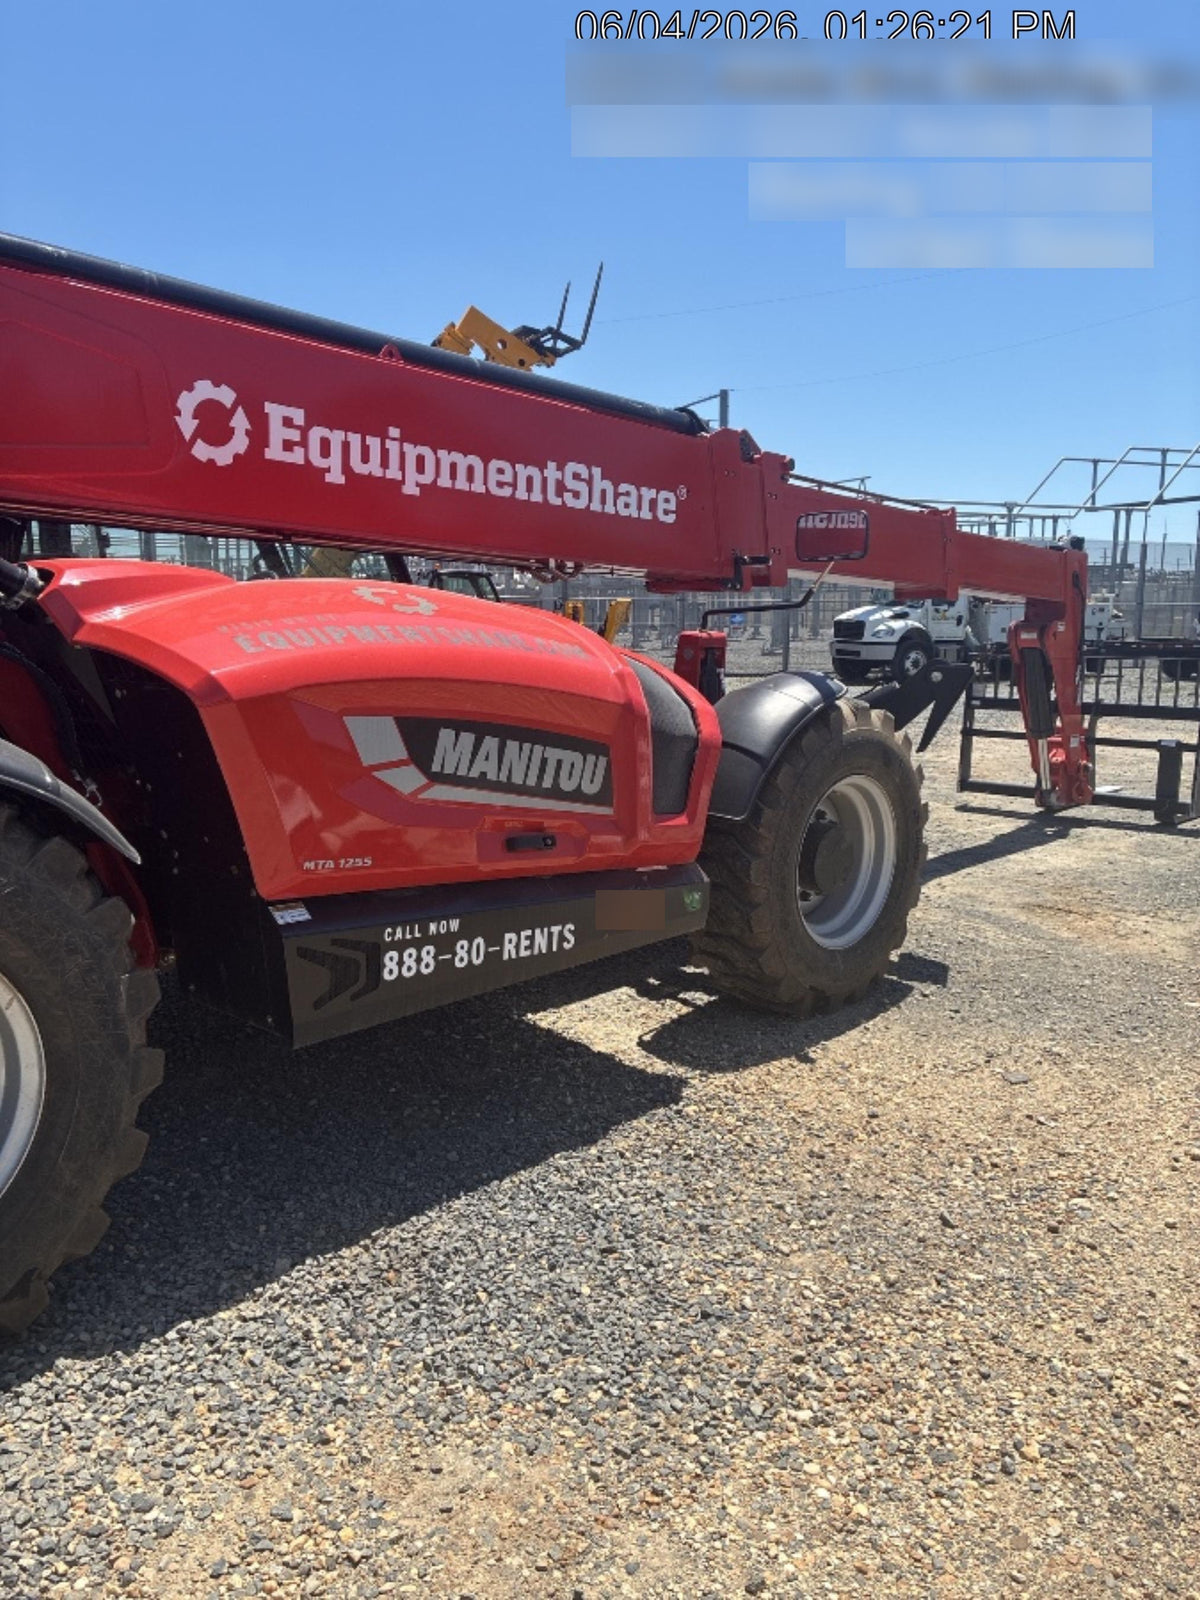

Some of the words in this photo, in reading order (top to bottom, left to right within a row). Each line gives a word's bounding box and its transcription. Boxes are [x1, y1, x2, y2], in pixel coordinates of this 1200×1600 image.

[431, 727, 609, 795] MANITOU
[303, 859, 335, 871] MTA
[384, 923, 422, 942] CALL
[429, 918, 461, 936] NOW
[383, 923, 576, 981] 888-80-RENTS
